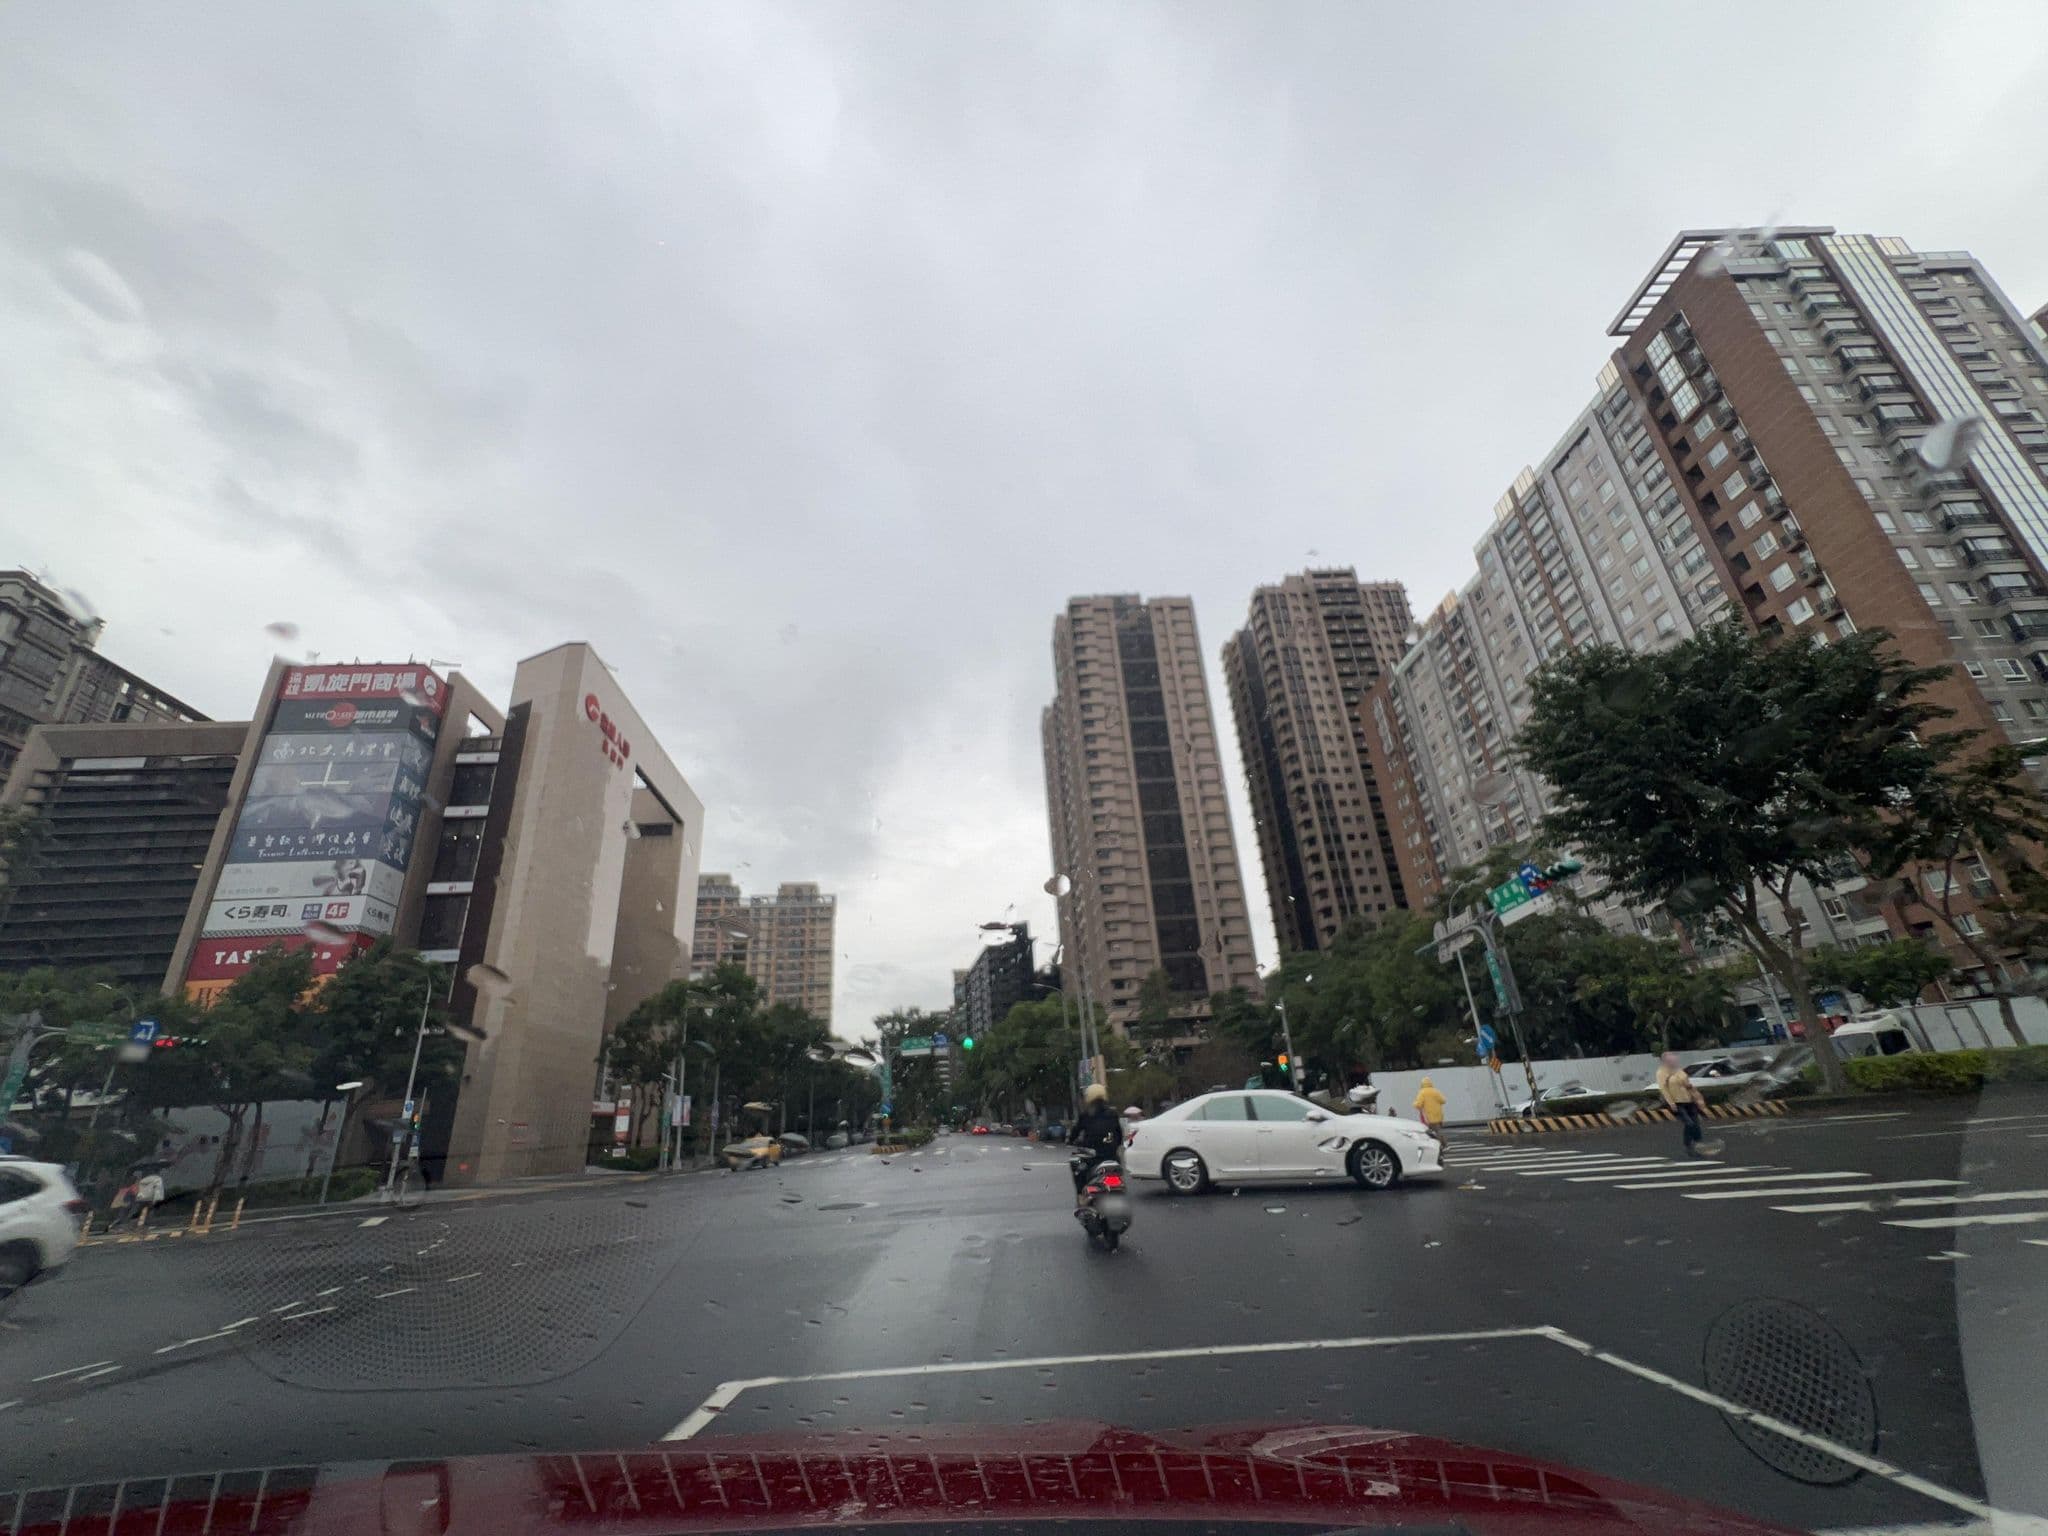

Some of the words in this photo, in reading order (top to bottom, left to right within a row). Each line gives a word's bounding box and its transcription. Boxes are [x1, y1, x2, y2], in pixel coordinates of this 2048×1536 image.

[302, 672, 416, 692] 凱旋門商場
[224, 904, 288, 920] くら寿司
[328, 903, 349, 918] 4F
